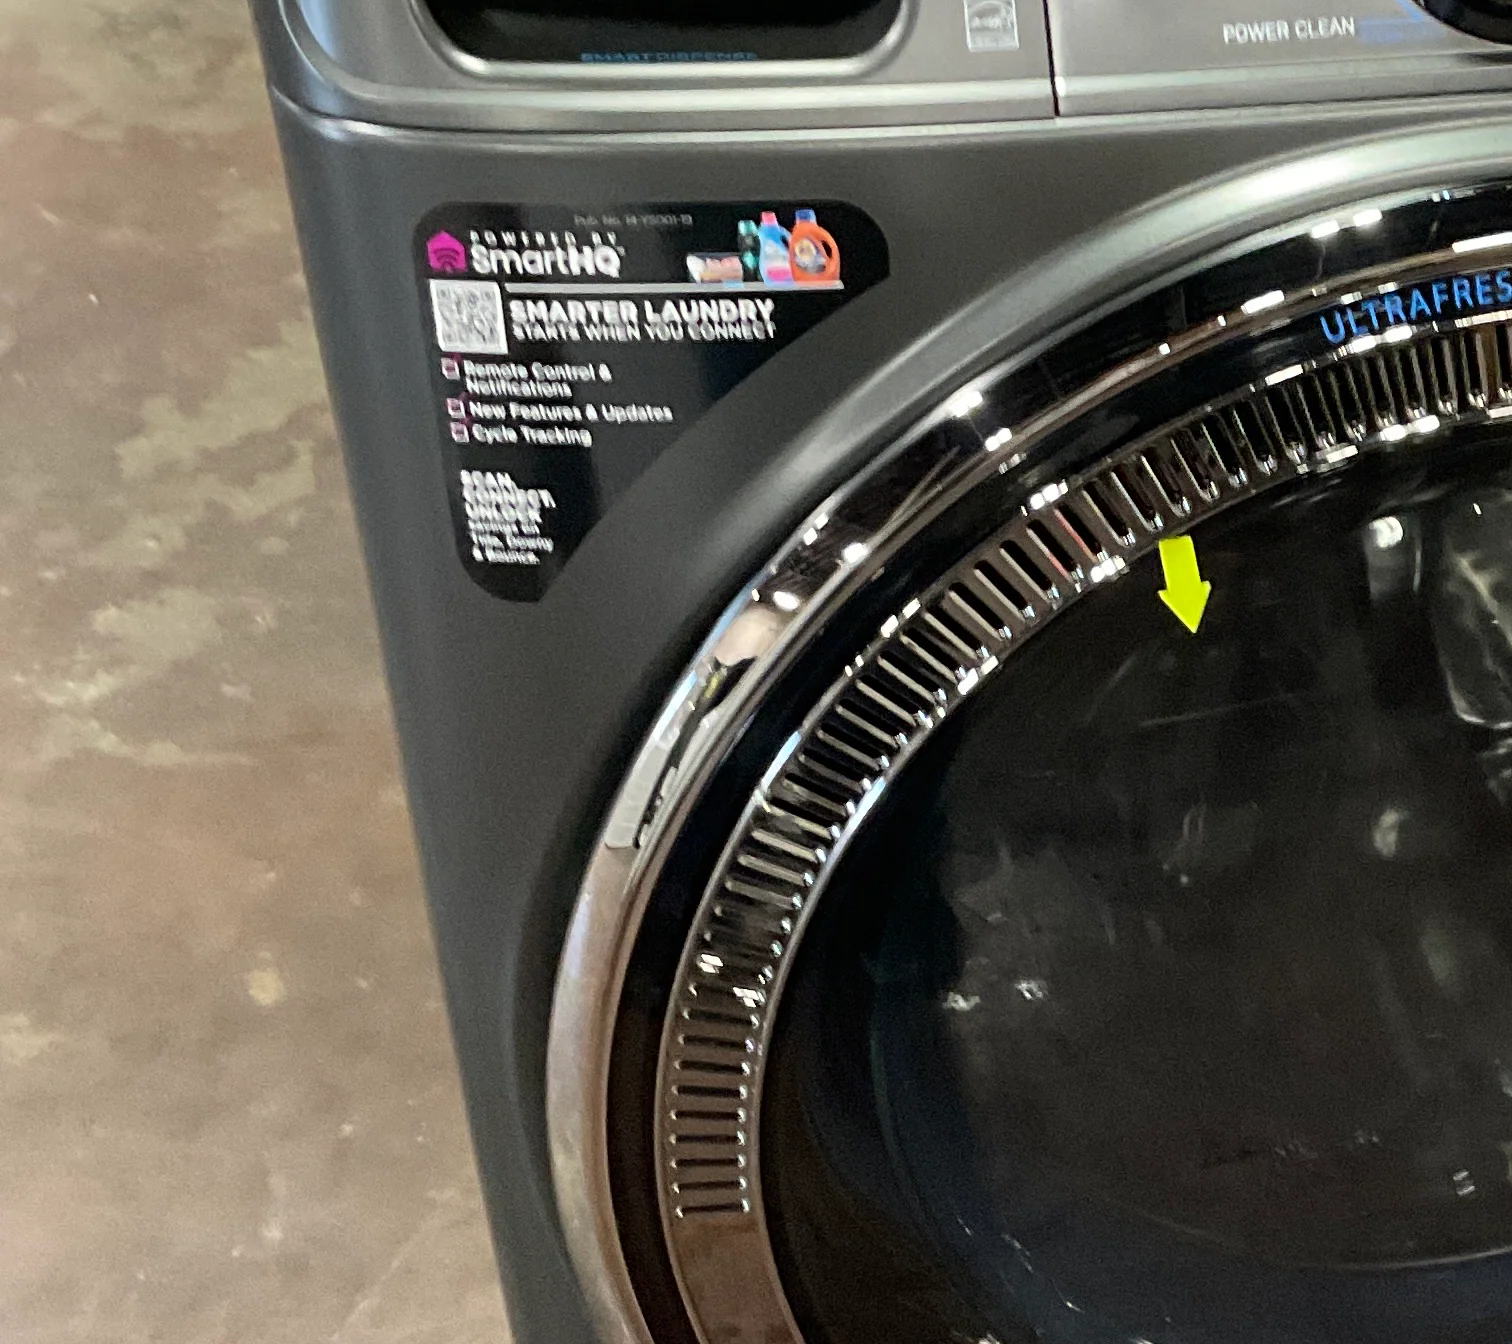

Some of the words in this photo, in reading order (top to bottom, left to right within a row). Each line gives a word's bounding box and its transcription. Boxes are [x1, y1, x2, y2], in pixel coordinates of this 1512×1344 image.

[1223, 19, 1290, 44] POWER
[1295, 14, 1356, 40] CLEAN
[470, 244, 620, 278] SmartHQ
[509, 299, 639, 324] SMARTER
[644, 298, 775, 323] LAUNDRY
[512, 322, 582, 342] STARTS
[584, 322, 641, 342] WHEN
[644, 321, 684, 341] YOU
[687, 321, 776, 341] CONNECT
[464, 360, 529, 380] Remote
[531, 361, 596, 382] Control
[465, 375, 573, 397] Notifications
[469, 401, 506, 420] New
[509, 402, 583, 422] Features
[601, 403, 674, 424] Updates
[472, 424, 518, 444] Cycle
[519, 425, 593, 447] Tracking
